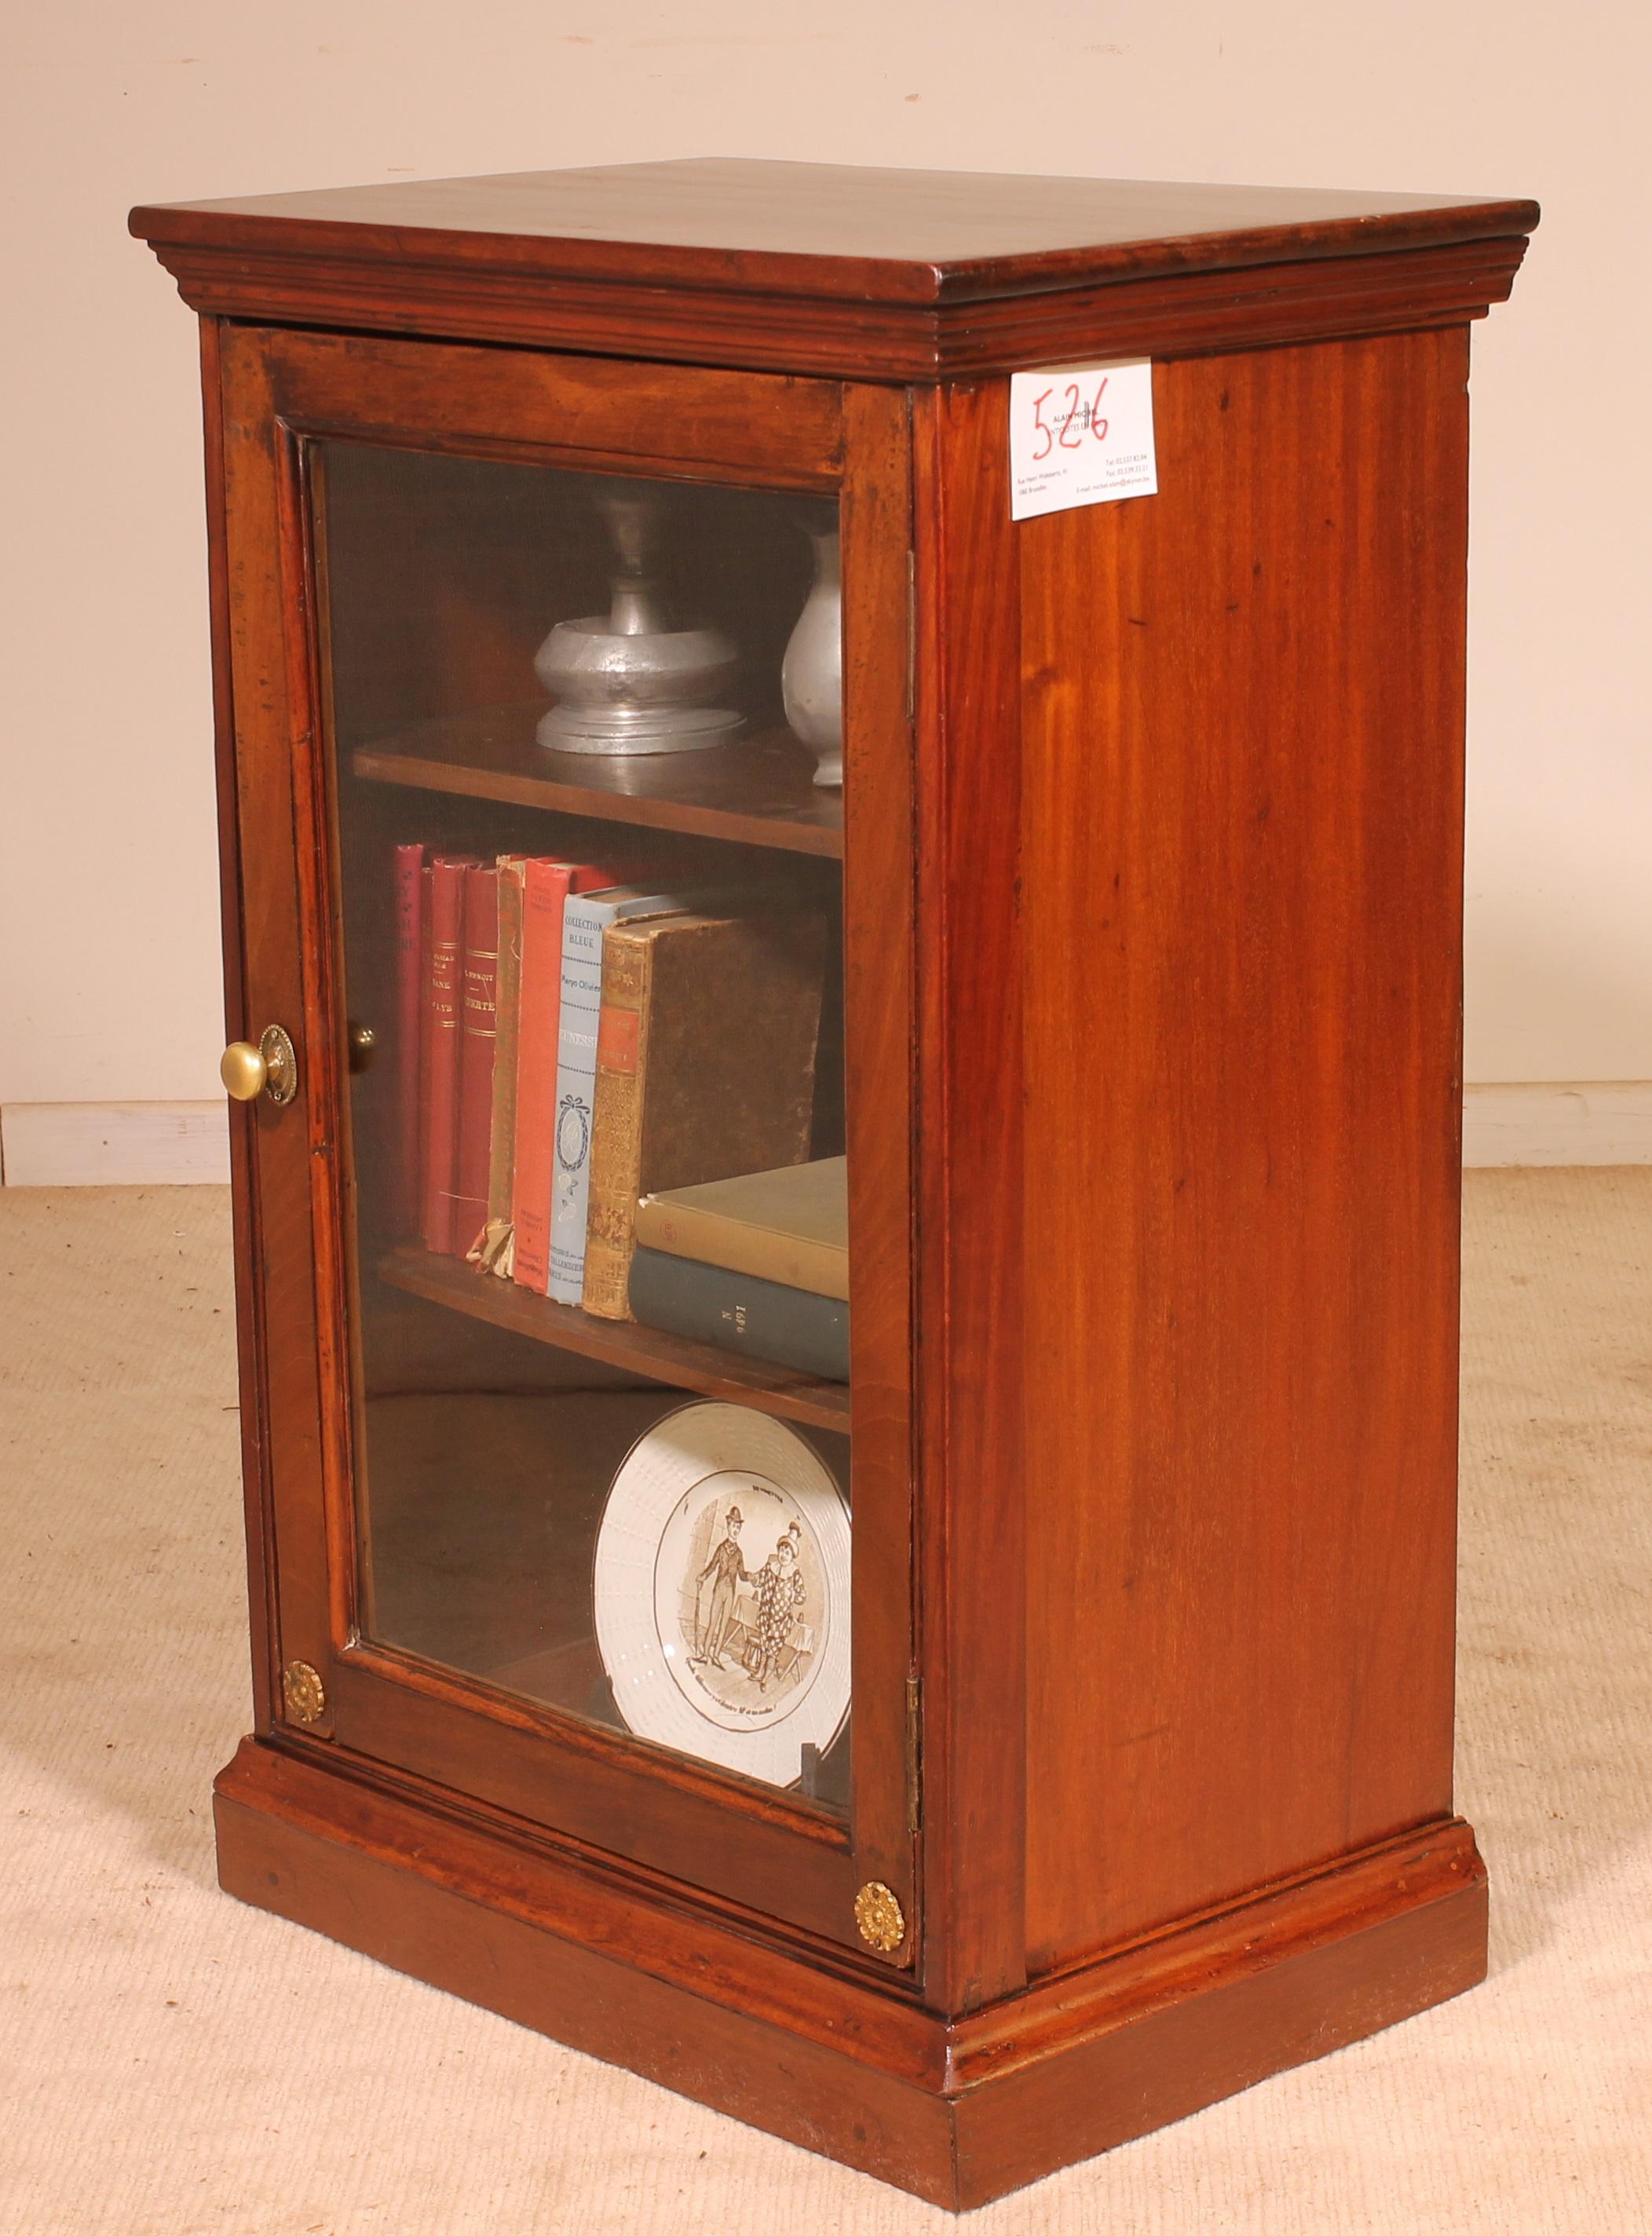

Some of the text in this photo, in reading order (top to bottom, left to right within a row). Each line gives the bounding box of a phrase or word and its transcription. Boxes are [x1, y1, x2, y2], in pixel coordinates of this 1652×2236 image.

[1032, 377, 1109, 460] 526
[565, 915, 603, 932] COLLECTION
[569, 934, 594, 948] BLEUE
